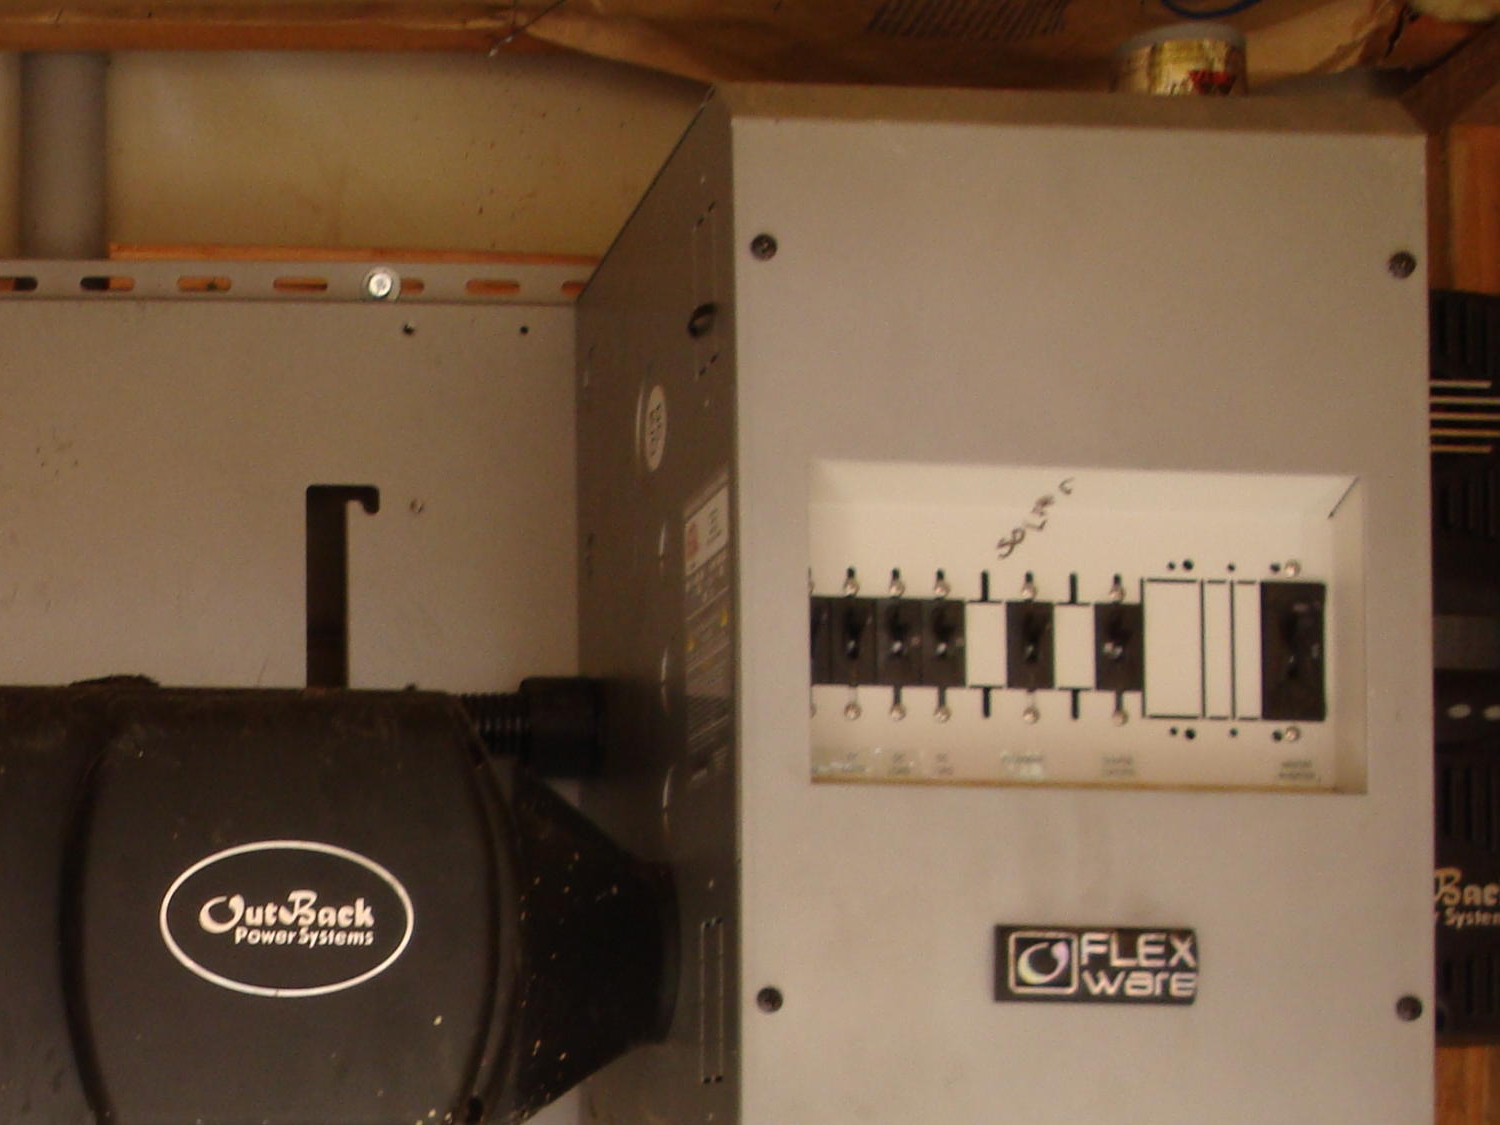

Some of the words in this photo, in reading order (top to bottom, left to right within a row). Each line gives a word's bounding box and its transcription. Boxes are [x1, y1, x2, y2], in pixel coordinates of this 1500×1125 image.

[199, 889, 375, 934] OutBack
[235, 925, 297, 945] Power
[299, 926, 375, 949] Systems
[1080, 932, 1197, 967] FLEX
